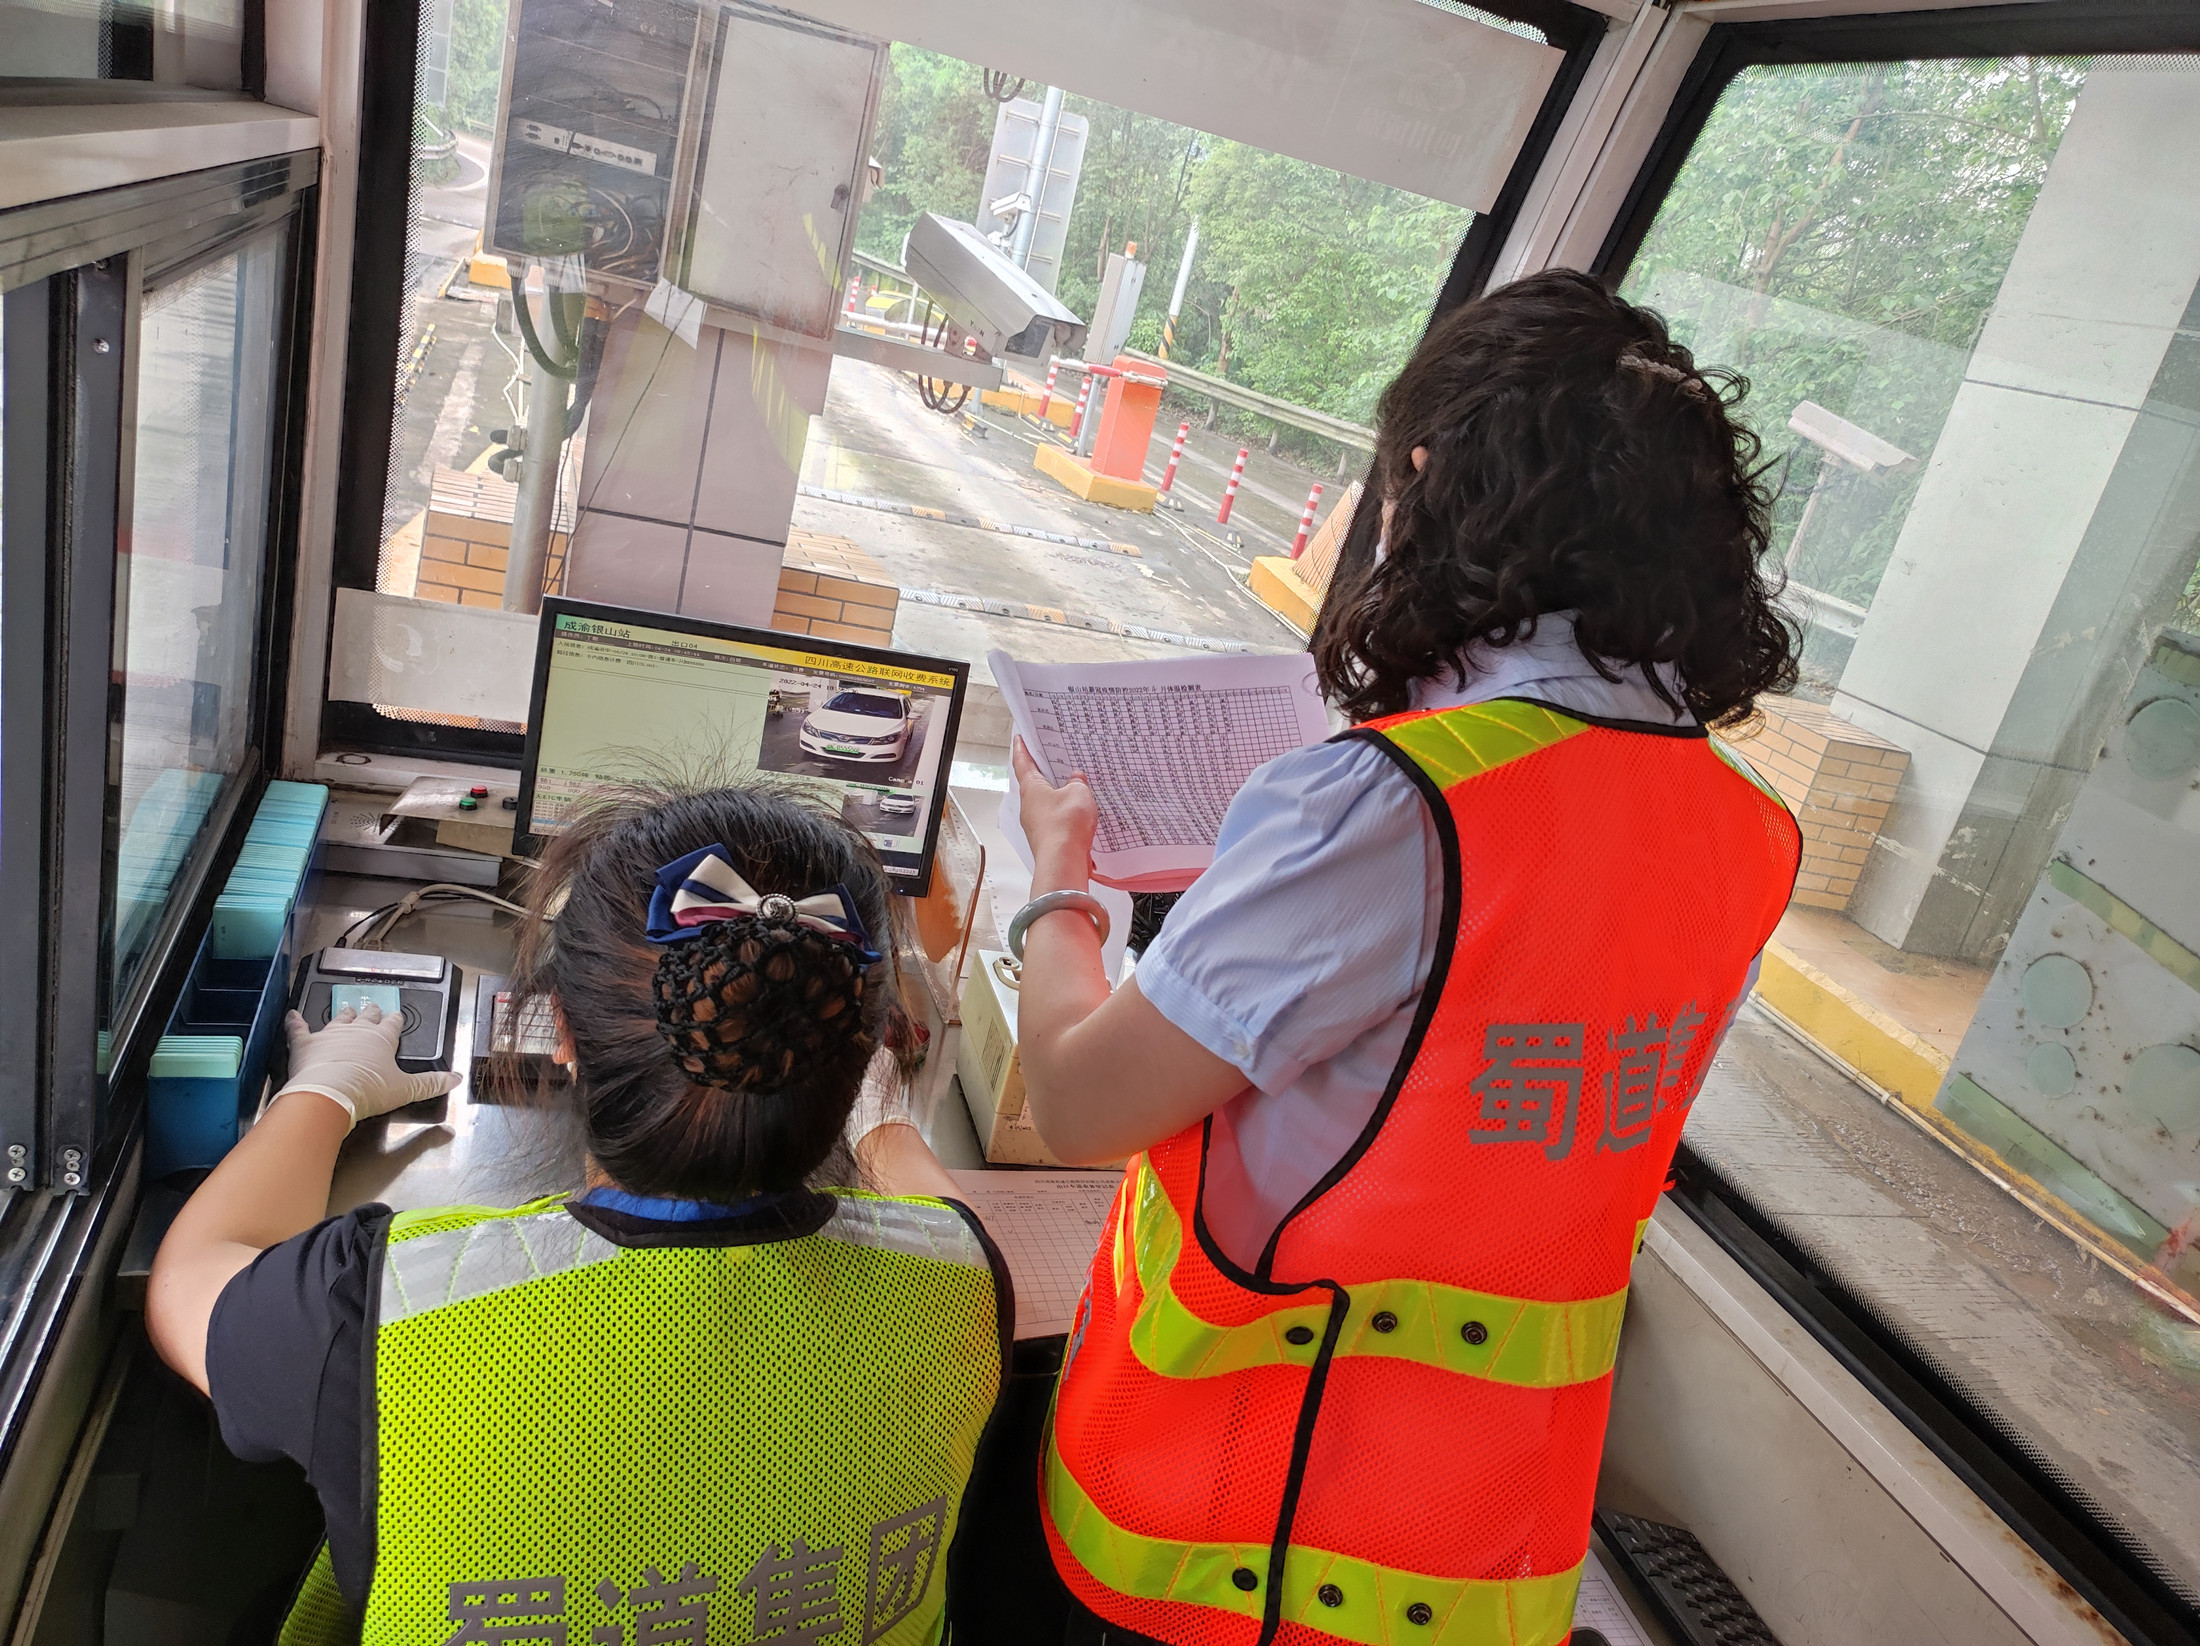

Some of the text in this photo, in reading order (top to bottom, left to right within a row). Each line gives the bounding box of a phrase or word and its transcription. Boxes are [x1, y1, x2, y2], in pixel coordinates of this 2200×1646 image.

[563, 621, 631, 638] 成渝银山站
[671, 640, 698, 649] 出口04
[804, 655, 951, 686] 四川高速公路联网收费系统
[779, 678, 822, 689] 2022-04-24
[888, 776, 913, 785] Camera
